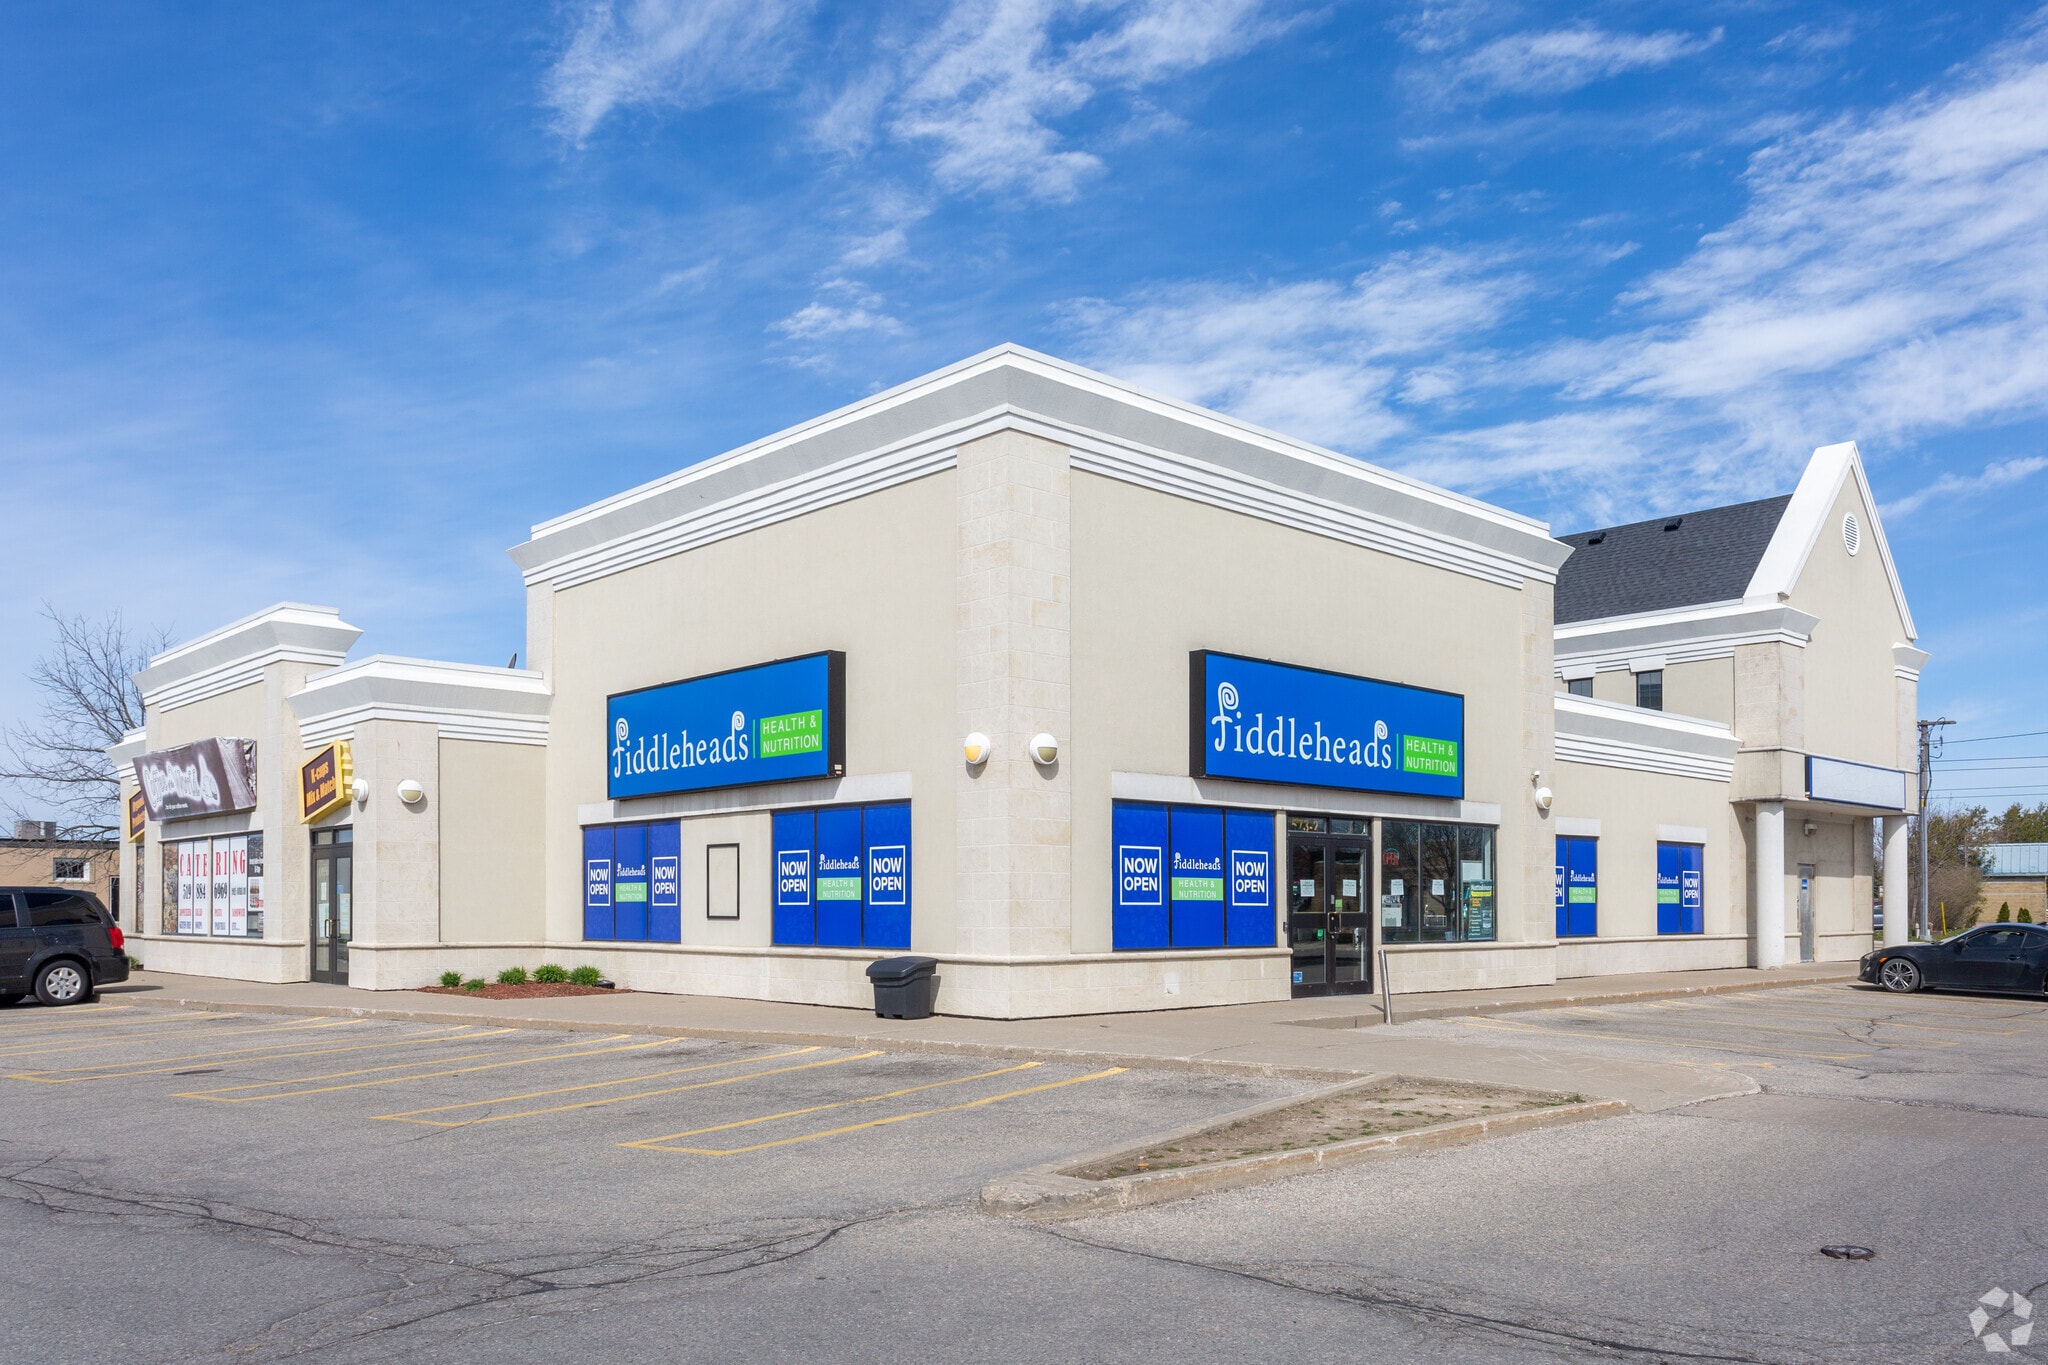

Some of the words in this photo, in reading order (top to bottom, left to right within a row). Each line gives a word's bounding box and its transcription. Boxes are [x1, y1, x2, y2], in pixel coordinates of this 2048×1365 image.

[763, 717, 805, 735] HEALTH
[809, 714, 817, 728] &
[763, 733, 820, 754] NUTRITION
[1405, 739, 1445, 756] HEALTH
[1447, 744, 1454, 757] &
[1405, 756, 1456, 774] NUTRITION
[180, 849, 246, 877] CATERING
[781, 860, 807, 876] NOW
[873, 857, 903, 874] NOW
[1124, 857, 1158, 874] NOW
[1235, 861, 1265, 877] NOW
[590, 868, 608, 882] NOW
[654, 866, 675, 880] NOW
[589, 883, 608, 895] OPEN
[619, 884, 637, 892] HEALTH
[654, 882, 675, 895] OPEN
[781, 878, 807, 893] OPEN
[822, 879, 847, 888] HEALTH
[872, 876, 902, 891] OPEN
[1123, 876, 1158, 892] OPEN
[1178, 879, 1208, 888] HEALTH
[1235, 878, 1265, 893] OPEN
[1684, 877, 1699, 888] NOW
[196, 883, 206, 900] 884
[822, 889, 856, 898] NUTRITION
[1178, 889, 1217, 899] NUTRITION
[1555, 887, 1563, 897] EN
[1684, 889, 1699, 899] OPEN
